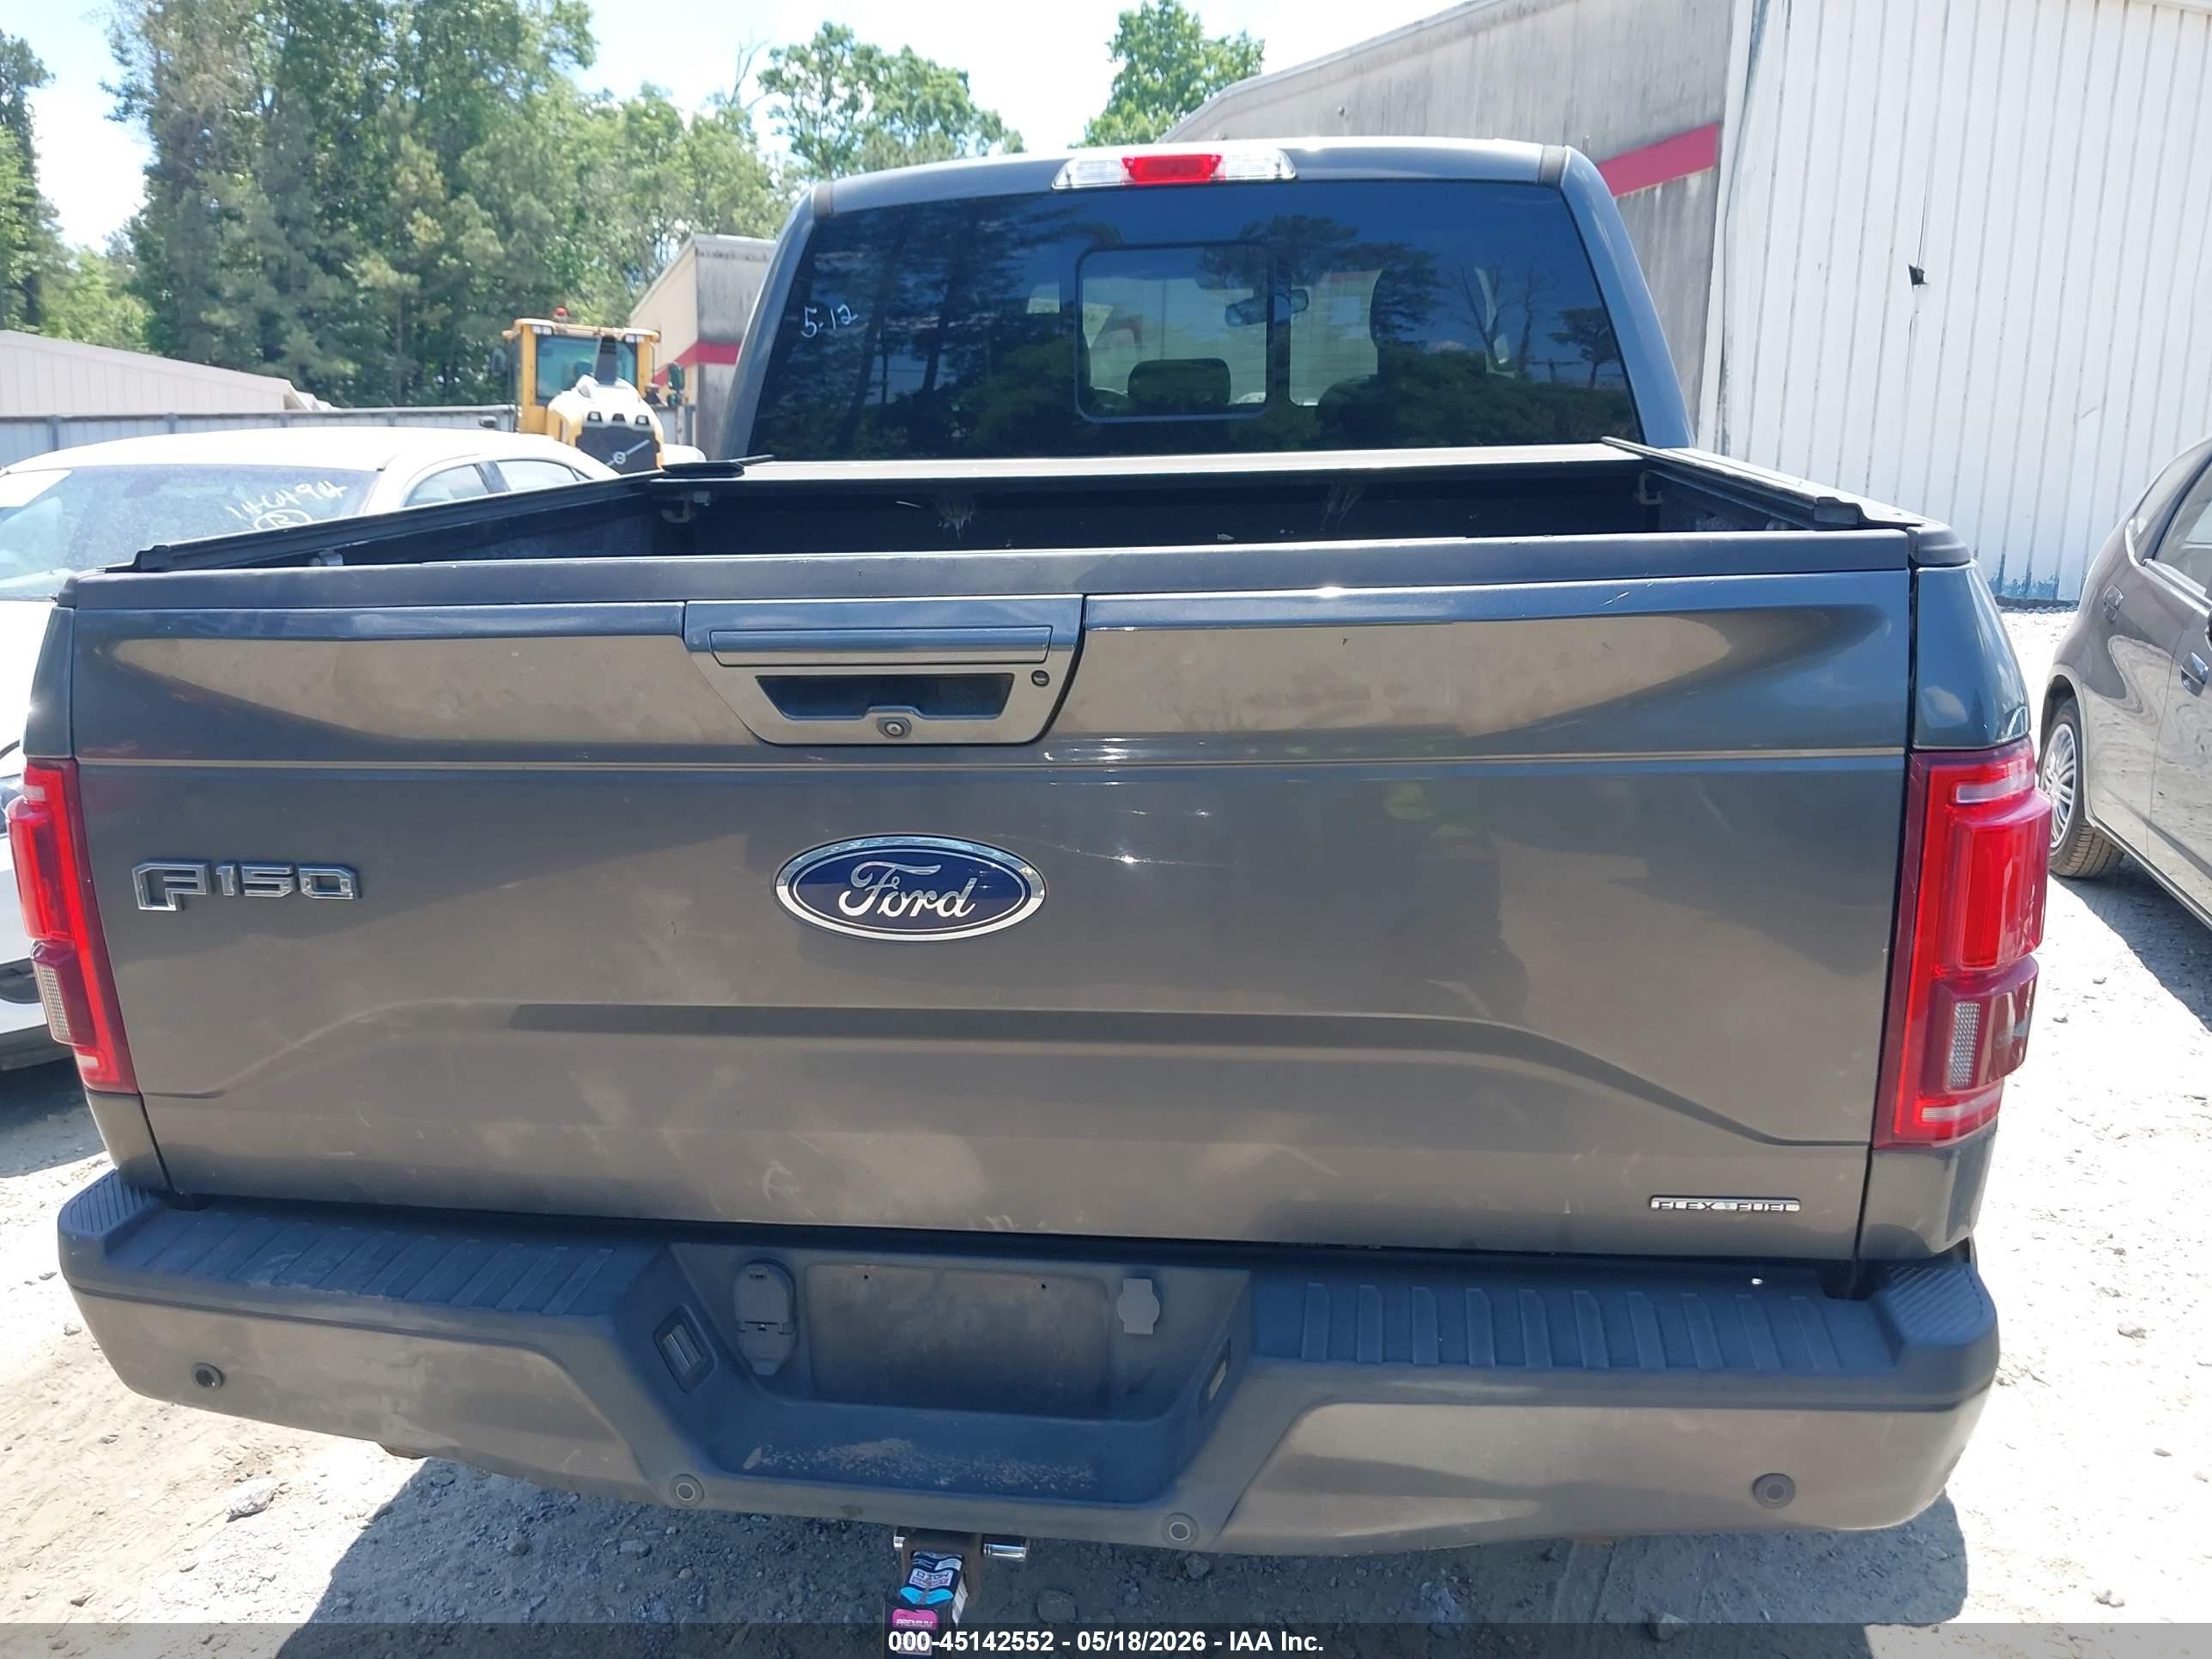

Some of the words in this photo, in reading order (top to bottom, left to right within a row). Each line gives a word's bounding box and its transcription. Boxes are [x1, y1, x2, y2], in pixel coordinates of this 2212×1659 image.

[838, 860, 977, 917] Ford
[1657, 1200, 1717, 1211] FLEX
[1735, 1202, 1795, 1212] FUEL
[896, 1618, 933, 1629] PREMIUM
